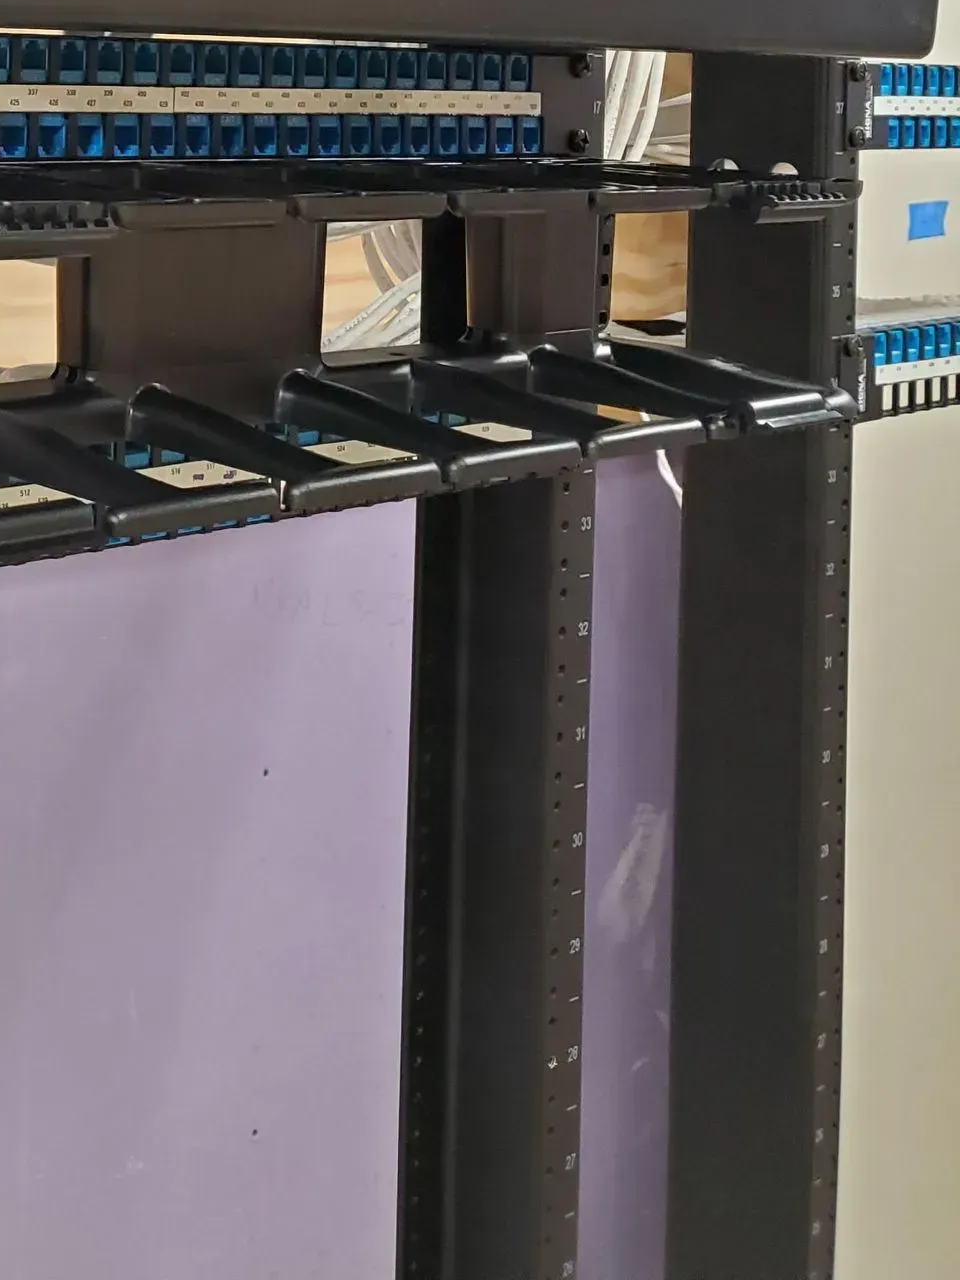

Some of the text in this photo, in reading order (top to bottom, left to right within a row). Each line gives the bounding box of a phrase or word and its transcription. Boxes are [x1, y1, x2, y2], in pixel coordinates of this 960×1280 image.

[28, 88, 38, 96] 337
[10, 98, 20, 106] 425
[20, 489, 30, 497] 512
[581, 516, 592, 531] 33
[578, 622, 589, 636] 32
[576, 726, 585, 741] 31
[572, 832, 583, 848] 30
[570, 937, 580, 954] 29
[568, 1045, 578, 1062] 28
[565, 1152, 576, 1170] 27
